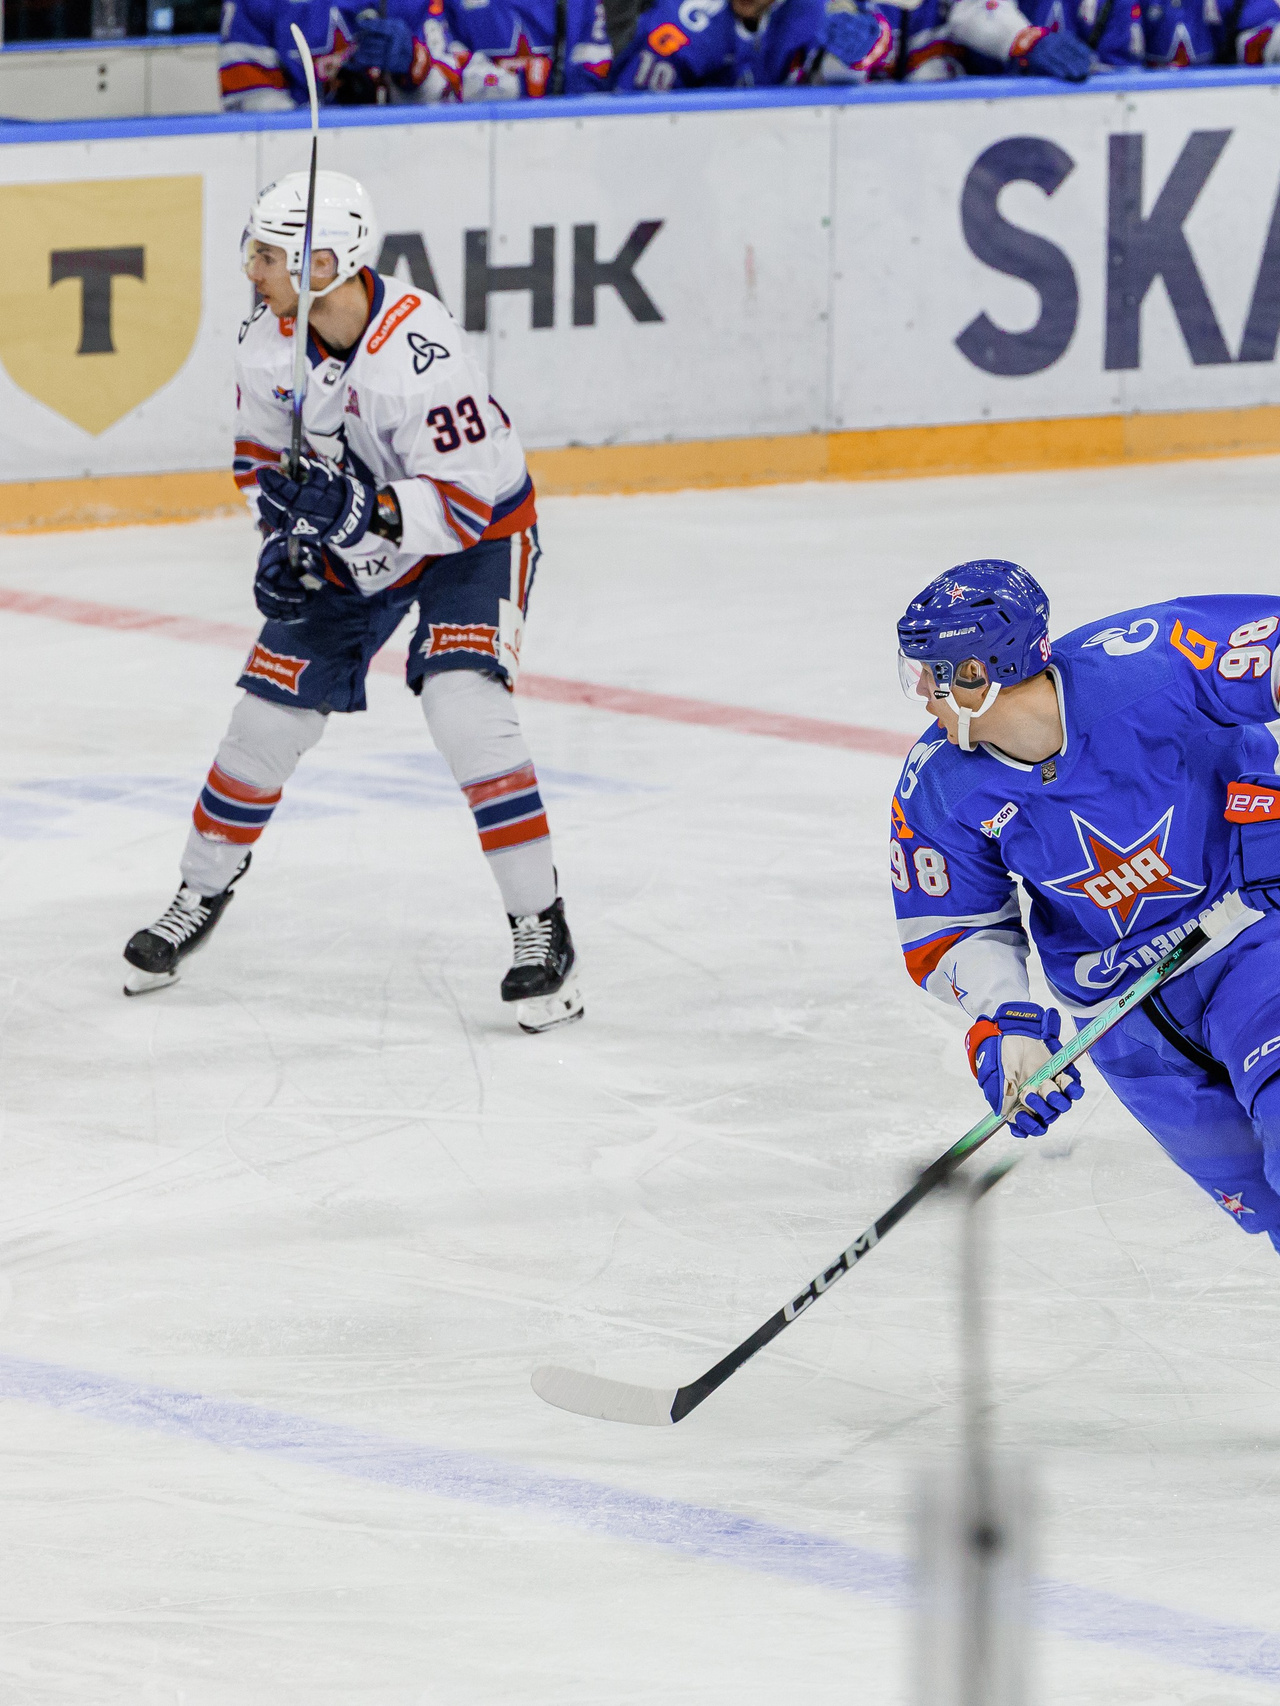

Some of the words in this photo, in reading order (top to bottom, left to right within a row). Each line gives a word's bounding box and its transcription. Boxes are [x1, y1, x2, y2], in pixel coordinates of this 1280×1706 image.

[375, 219, 666, 332] АНК
[426, 394, 486, 453] 33
[351, 556, 391, 577] НХ
[939, 626, 976, 639] BAUER
[1217, 616, 1280, 680] 98
[890, 838, 951, 897] 98
[1005, 1010, 1038, 1019] BAUER
[783, 1223, 881, 1322] CCM
